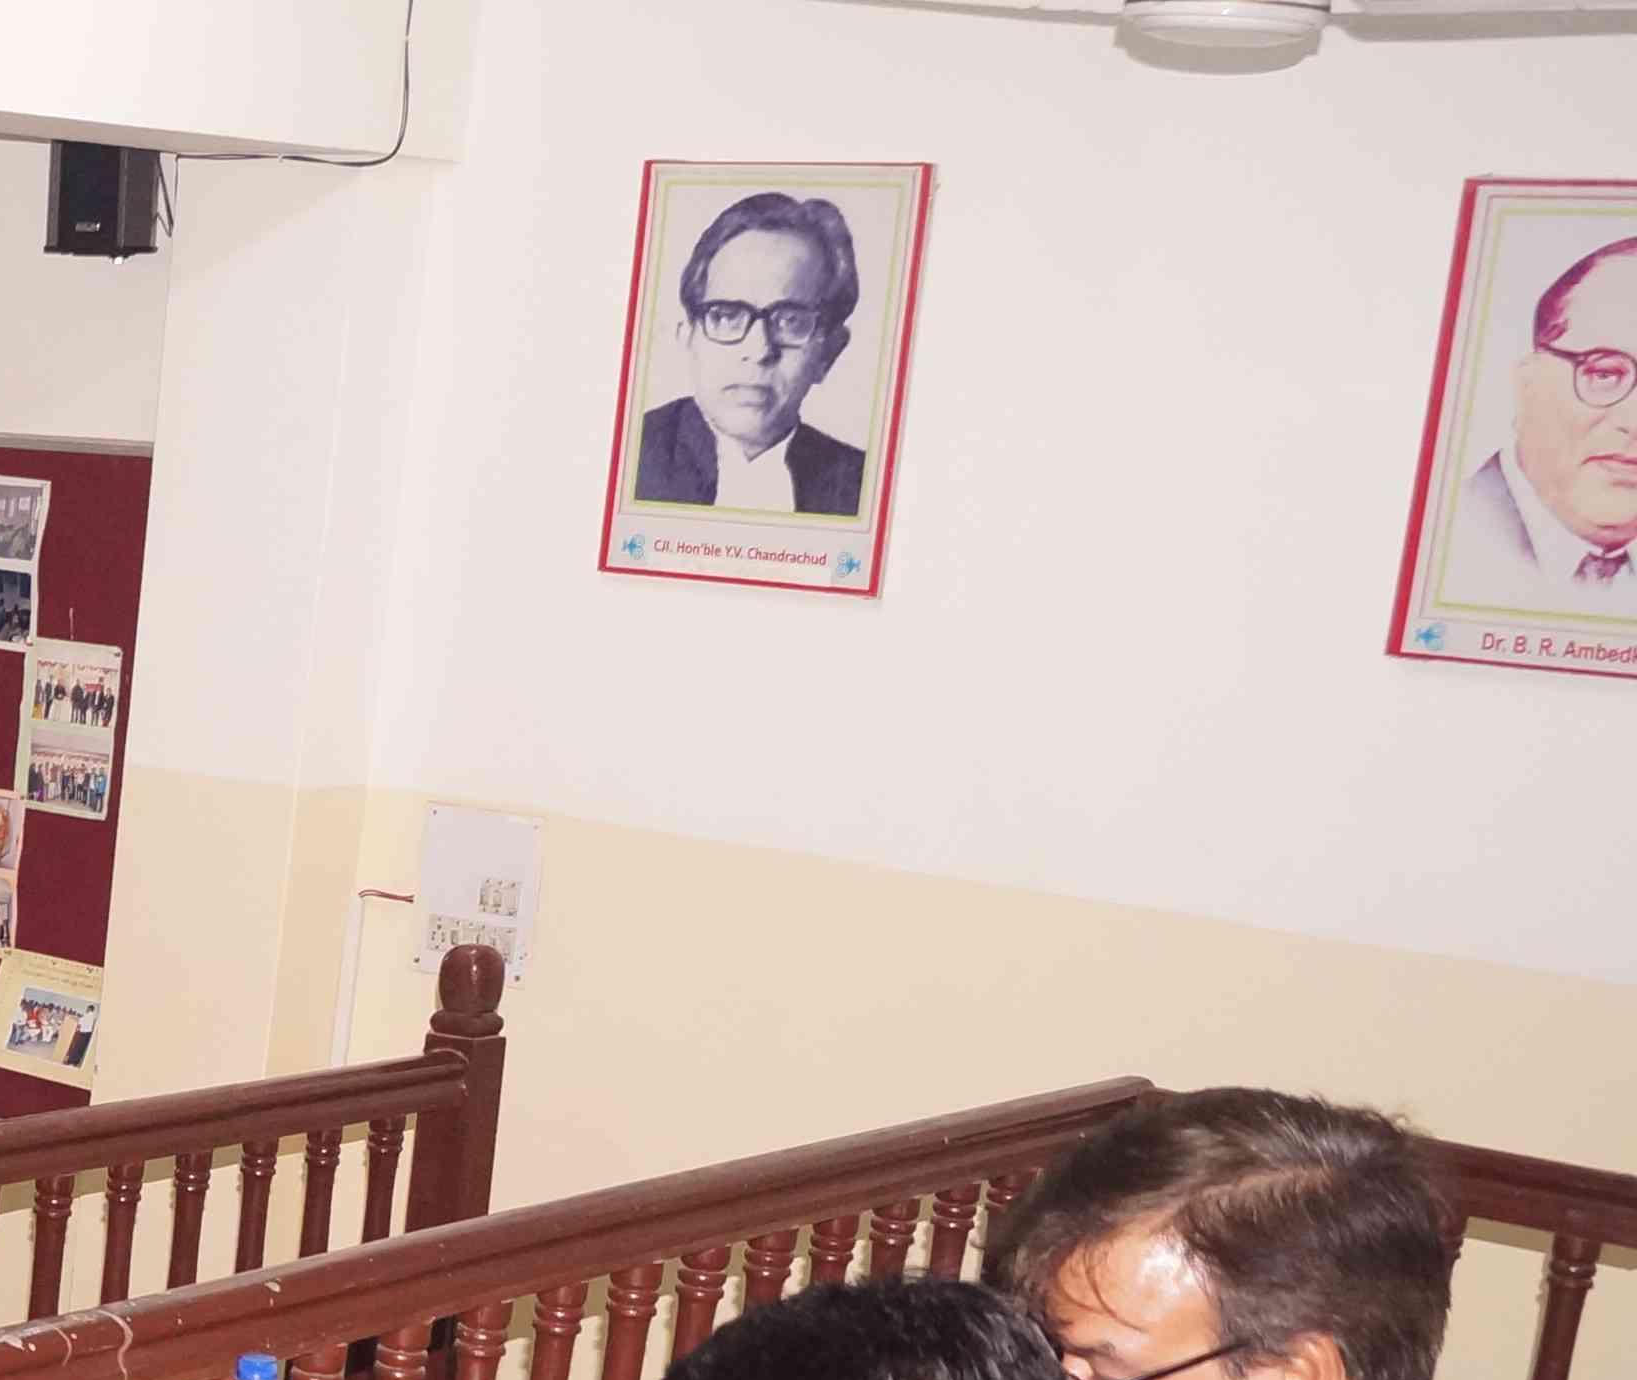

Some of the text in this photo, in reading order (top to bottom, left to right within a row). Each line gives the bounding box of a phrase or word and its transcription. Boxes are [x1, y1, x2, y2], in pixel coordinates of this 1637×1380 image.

[676, 542, 722, 558] Hon'ble
[724, 545, 743, 560] Y.V.
[747, 547, 828, 566] Chandrachud
[1481, 632, 1506, 652] Dr.
[1513, 635, 1531, 655] B.
[1538, 637, 1557, 657] R.
